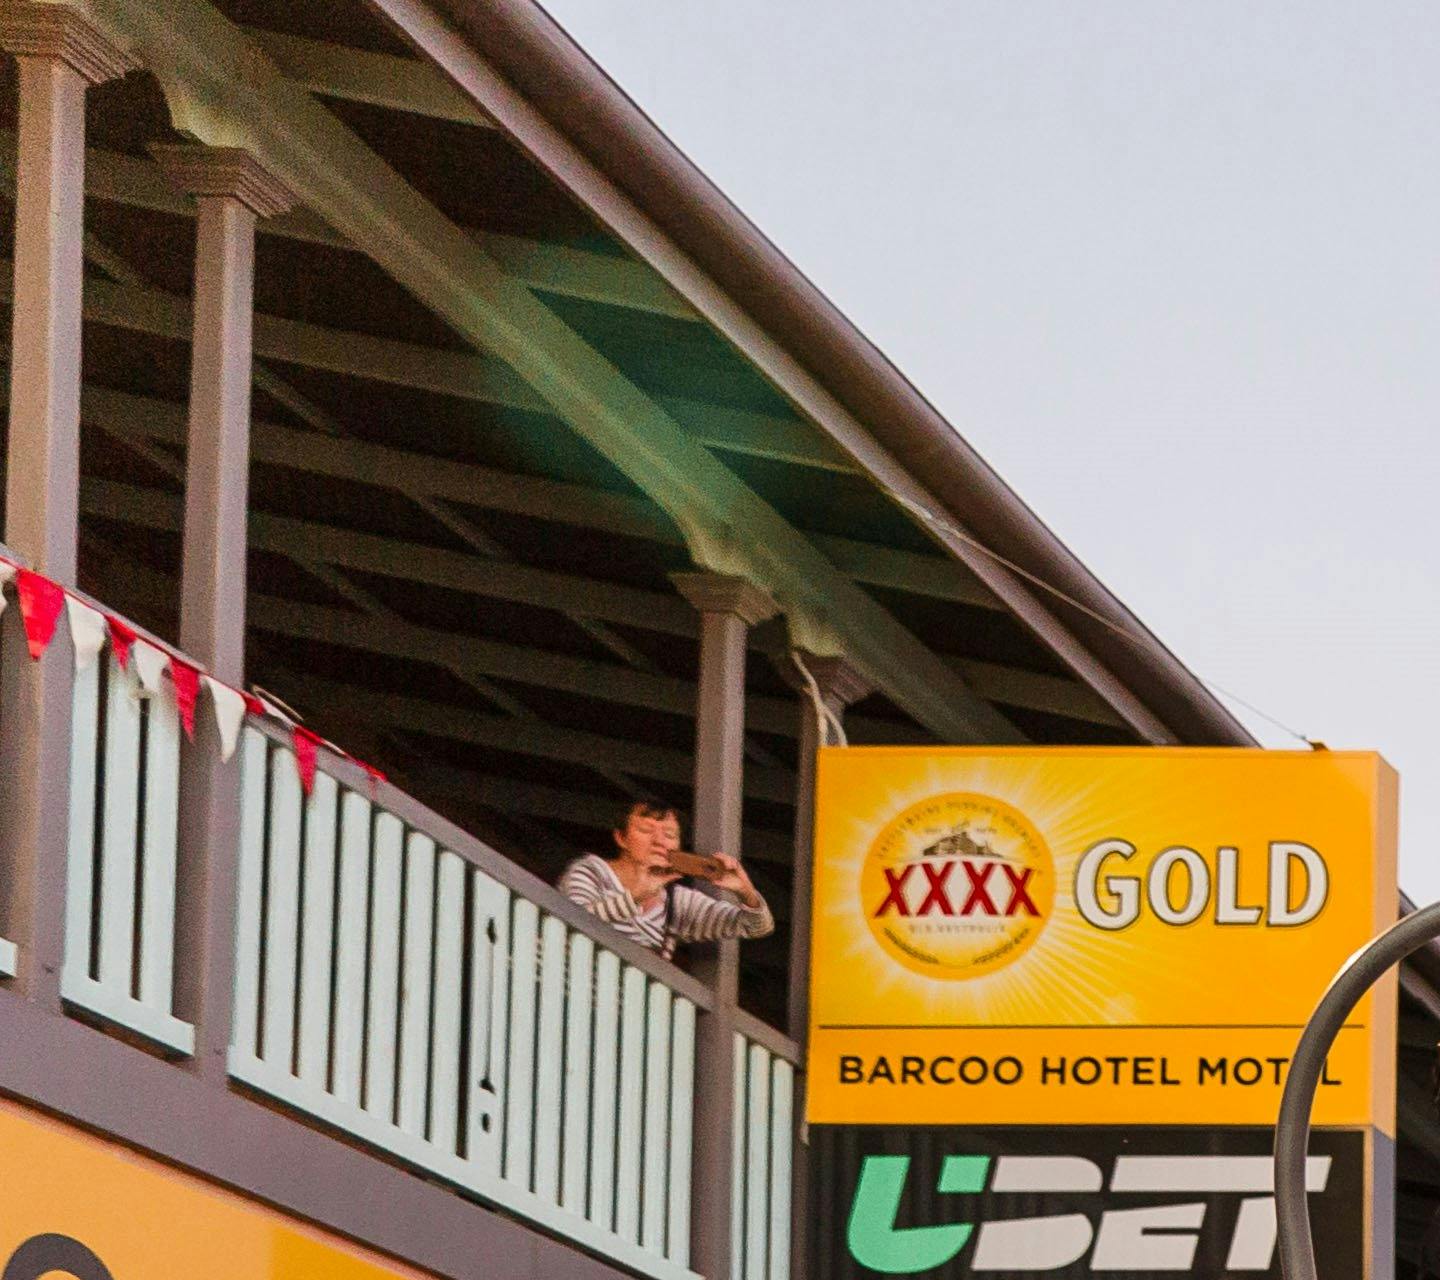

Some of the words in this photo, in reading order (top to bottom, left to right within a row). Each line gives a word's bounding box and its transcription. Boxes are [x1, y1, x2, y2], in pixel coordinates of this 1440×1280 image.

[874, 860, 1042, 918] XXXX
[1074, 838, 1330, 931] GOLD
[838, 1055, 1023, 1086] BARCOO
[1040, 1056, 1181, 1087] HOTEL
[1198, 1056, 1342, 1088] MOTL
[847, 1155, 1333, 1274] UBET
